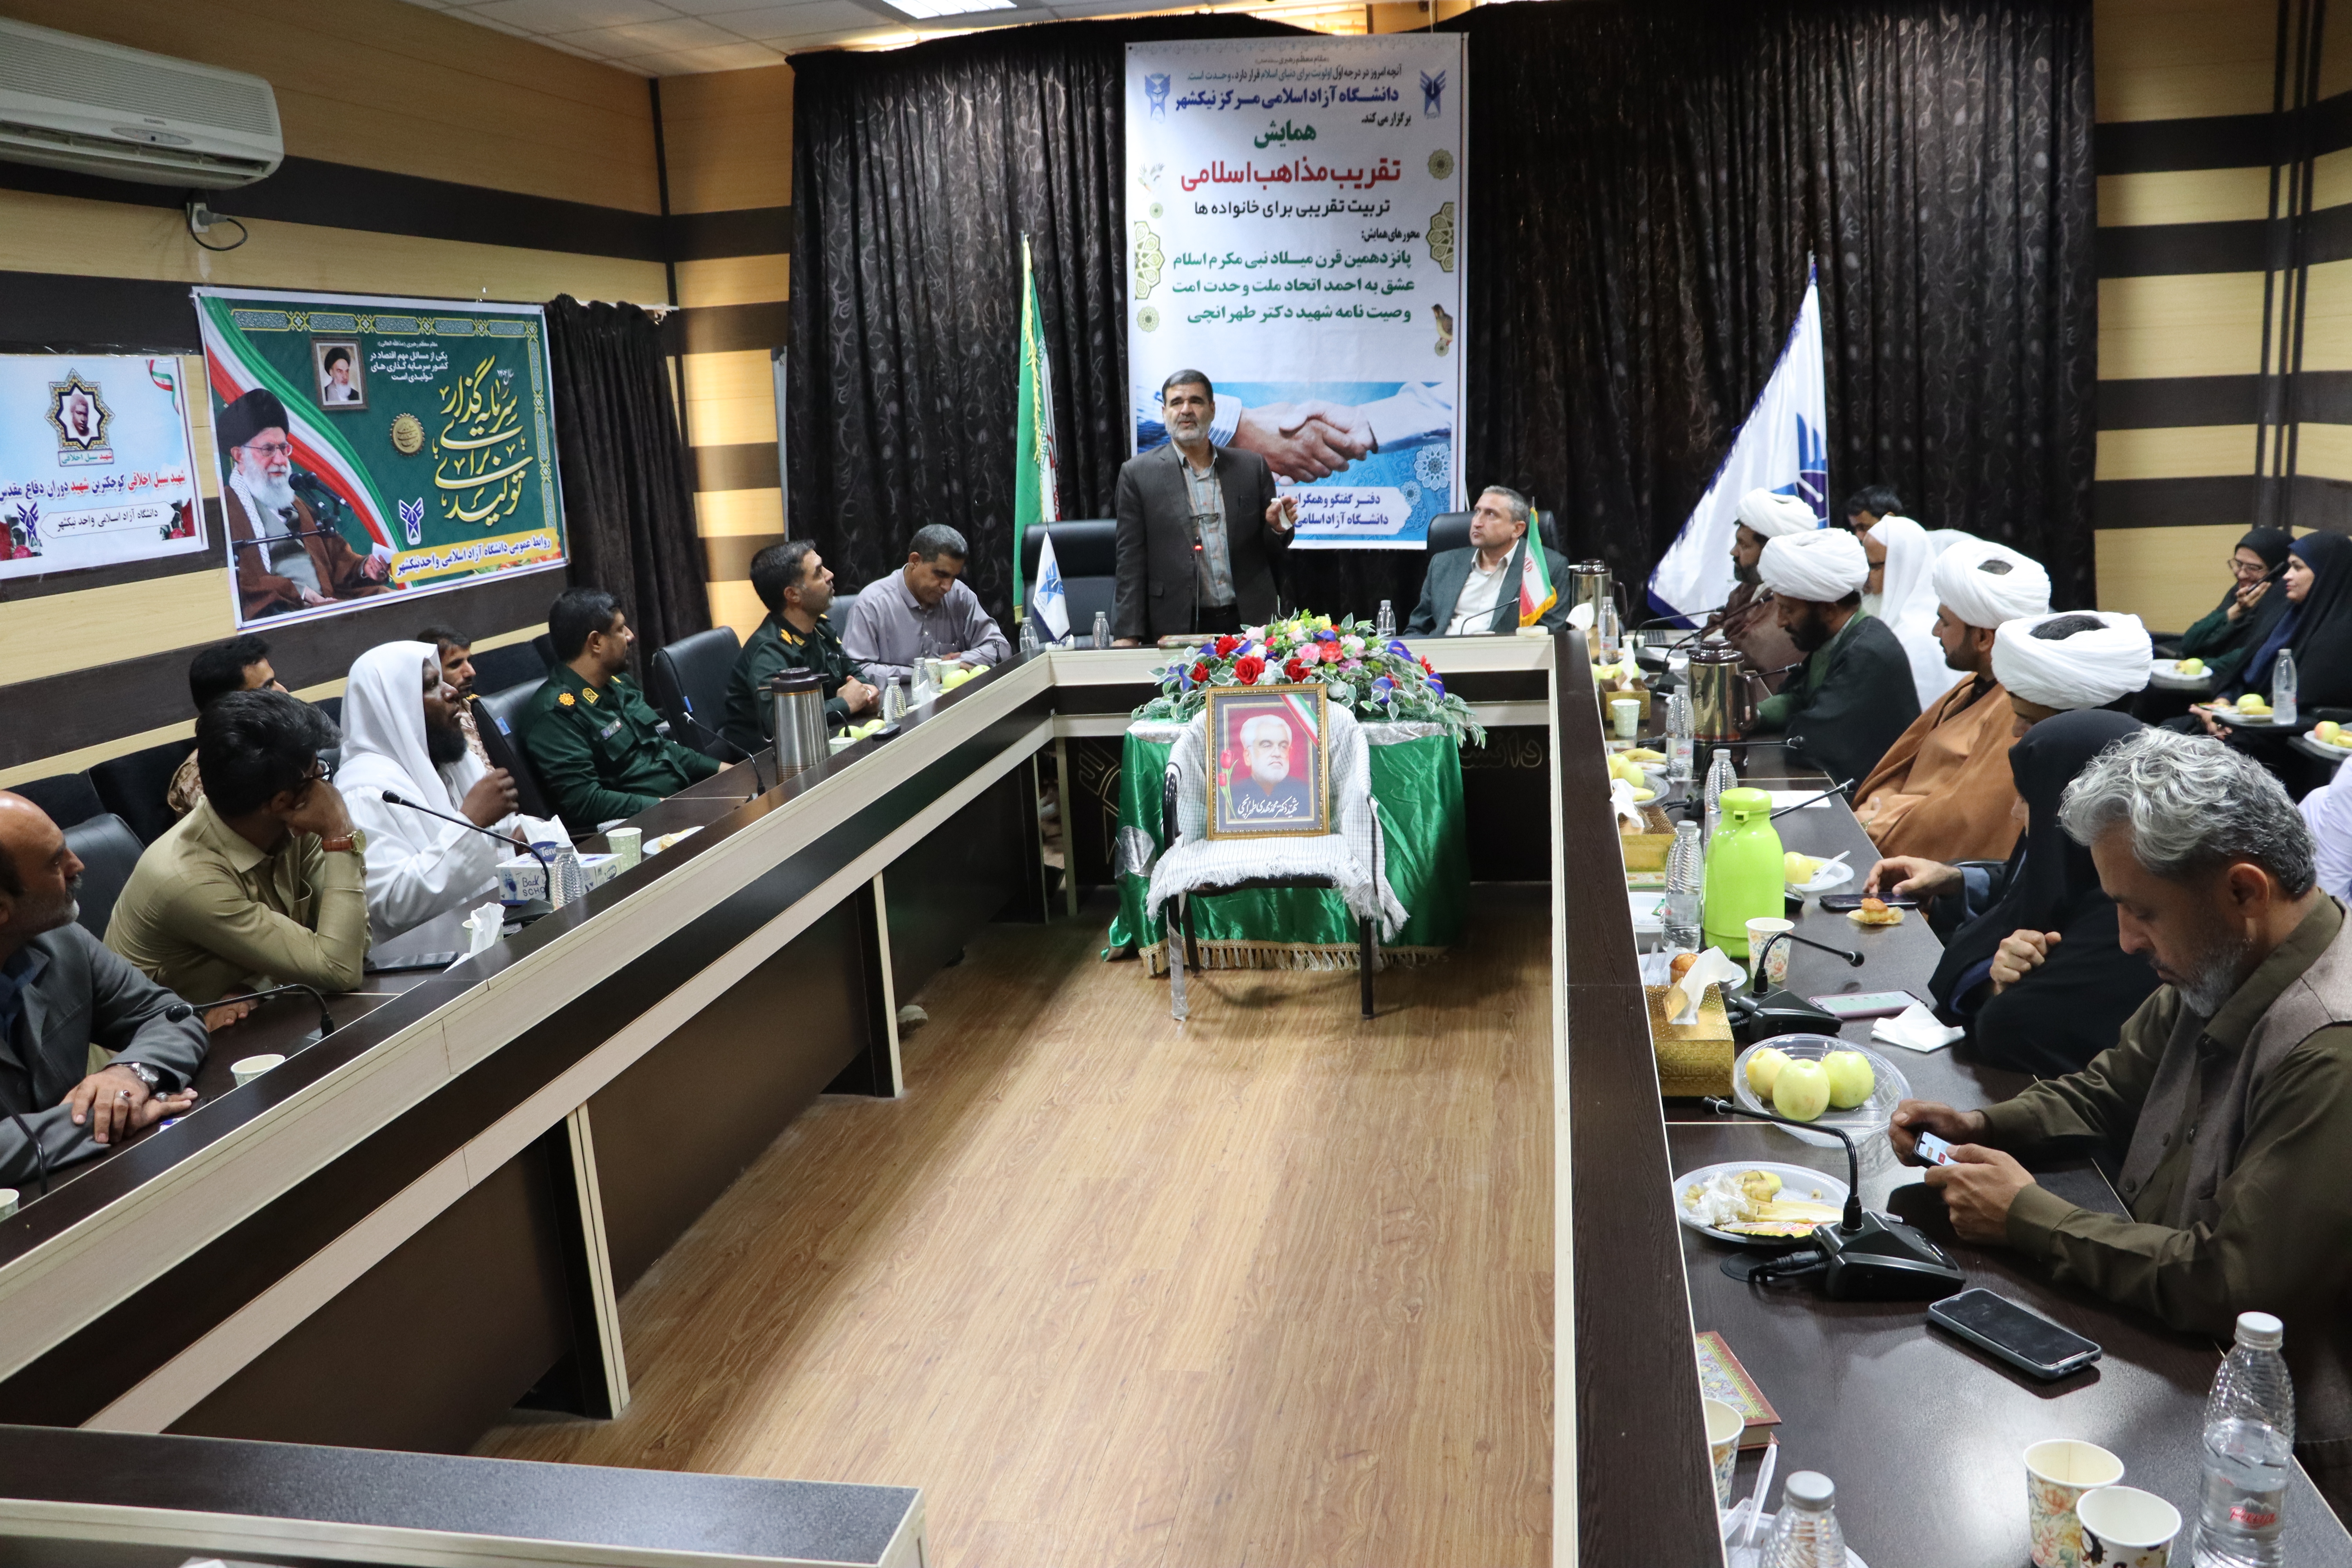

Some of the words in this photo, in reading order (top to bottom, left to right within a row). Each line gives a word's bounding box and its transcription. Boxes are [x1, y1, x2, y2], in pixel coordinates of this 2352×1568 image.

[1176, 90, 1216, 111] نیکشهر
[1261, 86, 1308, 109] اسلامی
[1309, 85, 1338, 108] آزاد
[1339, 85, 1399, 102] دانشگاه
[1254, 119, 1316, 149] همایش
[1181, 160, 1251, 192] اسلامی
[1254, 156, 1328, 191] مذاهب
[1330, 157, 1401, 189] تقریب
[1195, 201, 1209, 215] ها
[1211, 200, 1260, 218] خانواده
[1262, 200, 1293, 218] برای
[1296, 198, 1345, 218] تقریبی
[1347, 200, 1390, 217] تربیت
[1173, 252, 1207, 270] اسلام
[1209, 251, 1243, 270] مکرم
[1245, 250, 1269, 269] نبی
[1270, 250, 1313, 268] میلاد
[1315, 249, 1343, 269] قرن
[1344, 249, 1412, 269] پانزدهمین
[1172, 279, 1201, 292] امت
[1252, 278, 1281, 292] ملت
[1284, 278, 1321, 292] اتحاد
[1324, 278, 1362, 291] احمد
[1365, 280, 1378, 295] به
[1381, 278, 1415, 295] عشق
[1187, 304, 1257, 324] طهرانچی
[1258, 304, 1294, 323] دکتر
[1296, 305, 1333, 322] شهید
[1335, 304, 1364, 318] نامه
[1367, 307, 1411, 323] وصیت
[370, 352, 377, 361] در
[377, 350, 397, 359] اقتصاد
[436, 351, 448, 362] یکی
[432, 361, 449, 372] کشور
[408, 372, 434, 383] تولیدی
[127, 472, 151, 491] اخلاقی
[170, 469, 185, 485] شهید
[25, 479, 44, 500] دفاع
[47, 479, 69, 497] دوران
[71, 477, 89, 495] شهید
[444, 470, 526, 526] تولید
[1330, 492, 1354, 508] گفتگو
[1354, 492, 1381, 509] دفتر
[78, 515, 95, 527] واحد
[98, 512, 121, 527] اسلامی
[123, 508, 135, 523] آزاد
[138, 508, 158, 520] دانشگاه
[1294, 512, 1325, 528] اسلامی
[1326, 512, 1345, 528] آزاد
[1347, 512, 1389, 525] دانشگاه
[57, 517, 76, 532] نیکشهر
[485, 541, 507, 557] دانشگاه
[510, 540, 531, 554] عمومی
[532, 535, 552, 550] روابط
[441, 550, 466, 568] اسلامی
[468, 545, 482, 562] آزاد
[1285, 797, 1299, 818] شهید
[522, 875, 539, 887] Back
